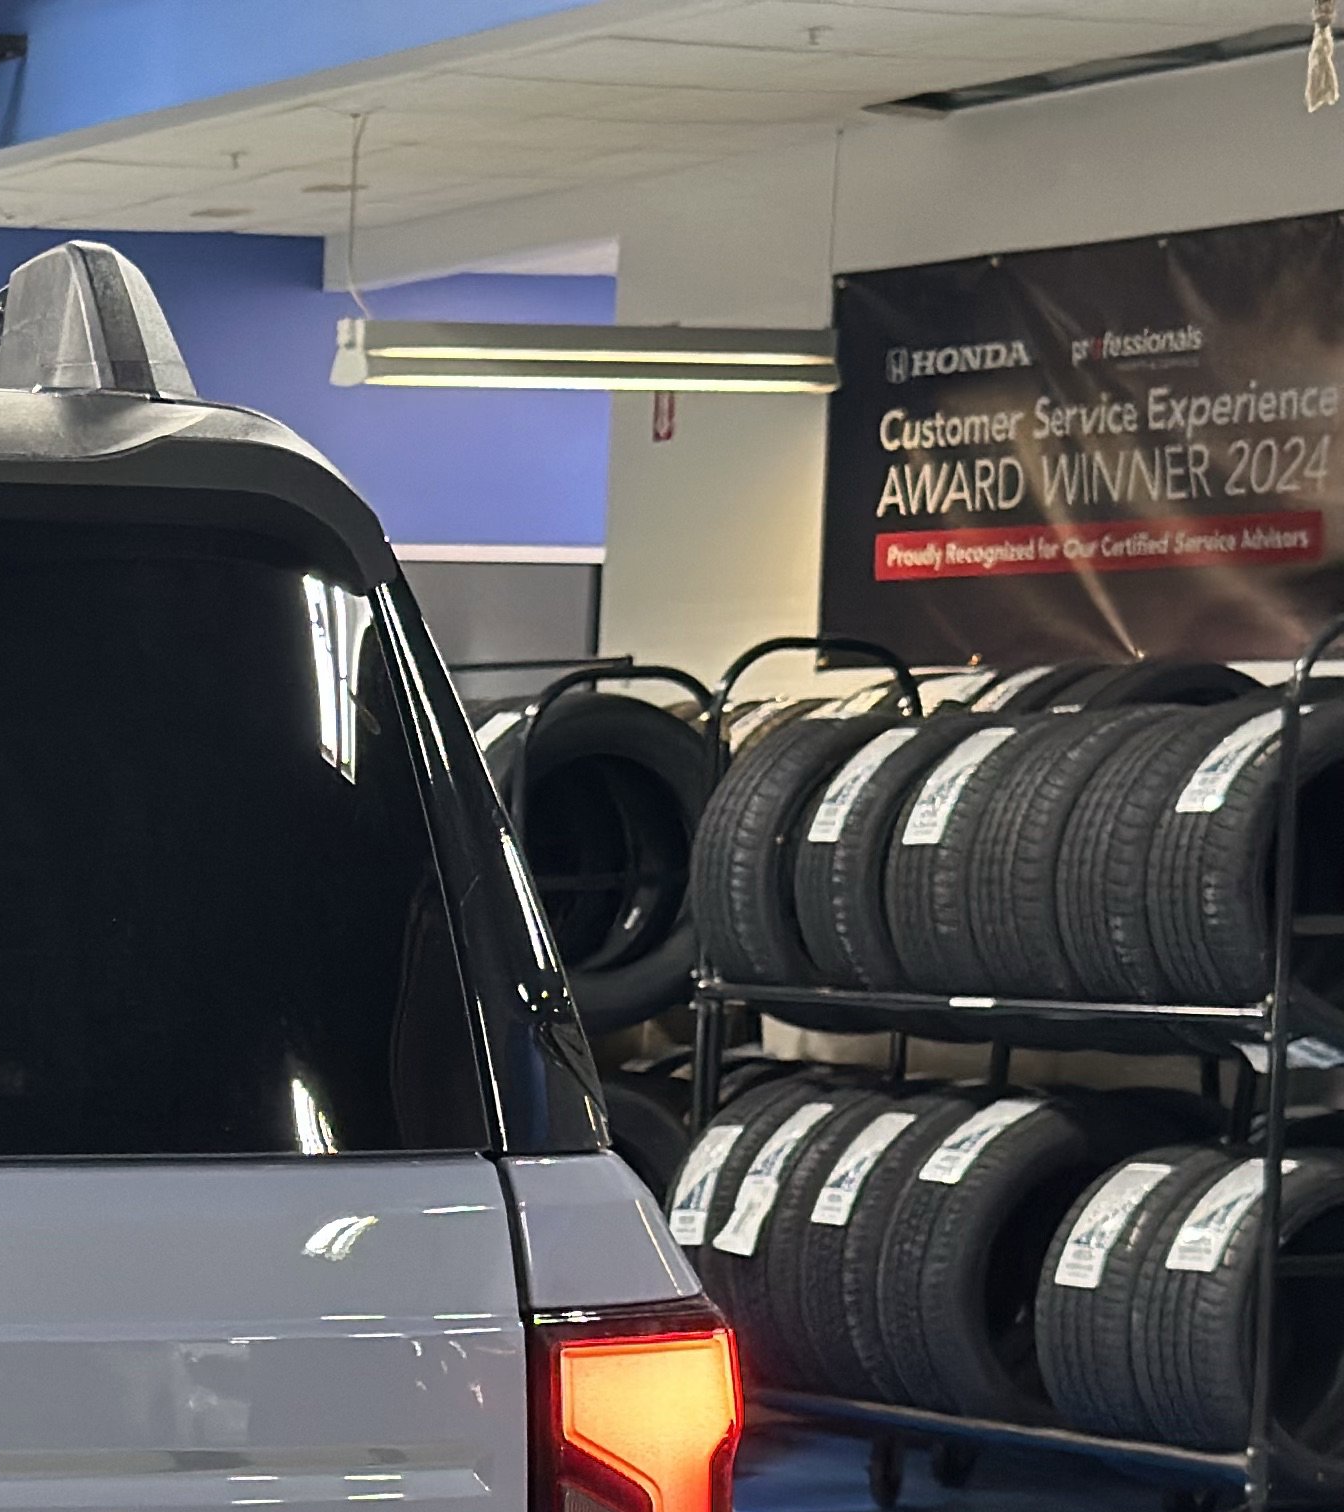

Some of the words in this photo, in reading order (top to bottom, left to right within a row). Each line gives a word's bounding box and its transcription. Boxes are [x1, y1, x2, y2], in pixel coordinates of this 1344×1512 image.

[911, 339, 1032, 378] HONDA
[879, 407, 1020, 452] Customer
[1033, 393, 1138, 441] Service
[1148, 380, 1340, 439] Experience
[876, 456, 1024, 518] AWARD
[1041, 444, 1212, 507] WINNER
[1224, 434, 1332, 497] 2024
[886, 543, 942, 571] Proudly
[945, 539, 1035, 569] Recognized
[1038, 535, 1059, 558] for
[1062, 536, 1097, 559] Our
[1100, 530, 1170, 557] Certified
[1173, 529, 1237, 554] Service
[1241, 526, 1310, 550] Advisors
